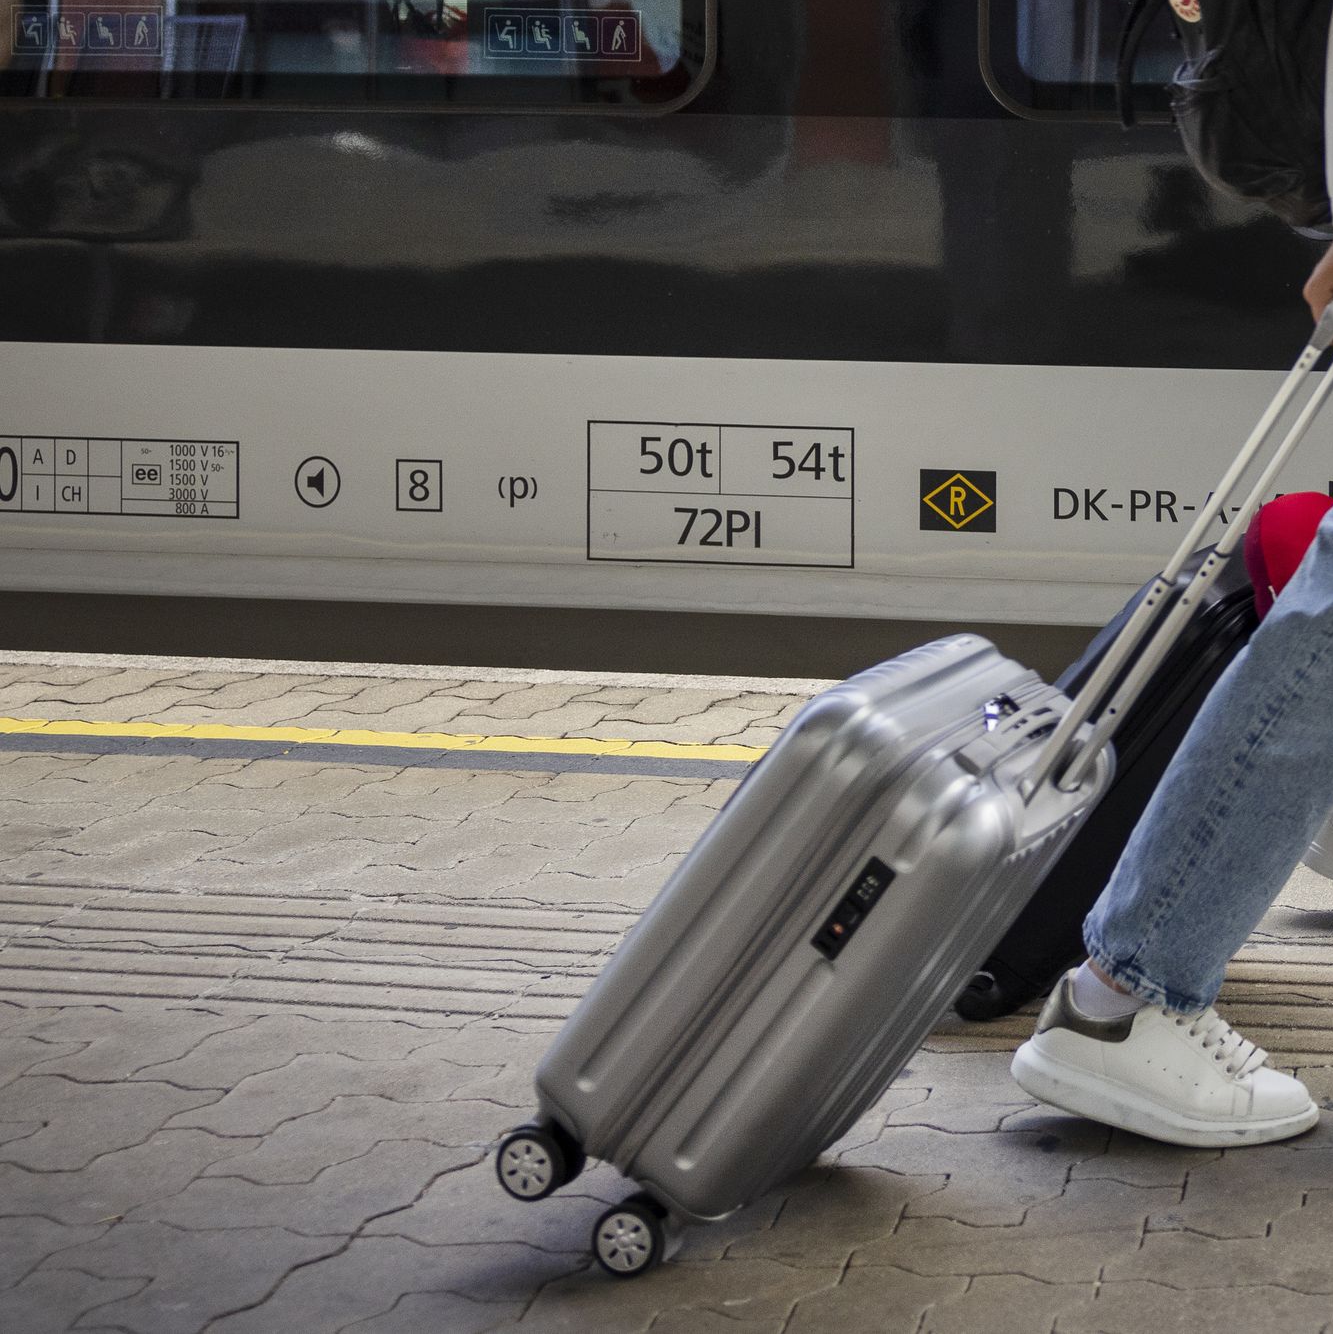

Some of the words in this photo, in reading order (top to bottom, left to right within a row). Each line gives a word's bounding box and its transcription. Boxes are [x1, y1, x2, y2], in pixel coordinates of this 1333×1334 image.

[33, 449, 43, 464] A
[67, 450, 76, 465] D
[170, 445, 195, 456] 1000
[201, 446, 208, 457] V
[640, 437, 712, 478] 50t
[170, 459, 195, 471] 1500
[201, 460, 208, 471] V
[773, 442, 845, 482] 54t
[136, 469, 158, 481] ee
[170, 474, 195, 486] 1500
[201, 474, 208, 486] V
[409, 470, 429, 501] 8
[499, 477, 537, 507] (p)
[62, 486, 81, 501] CH
[168, 488, 197, 500] 3000
[200, 489, 209, 500] V
[949, 486, 967, 516] R
[175, 503, 196, 515] 800
[200, 504, 209, 515] A
